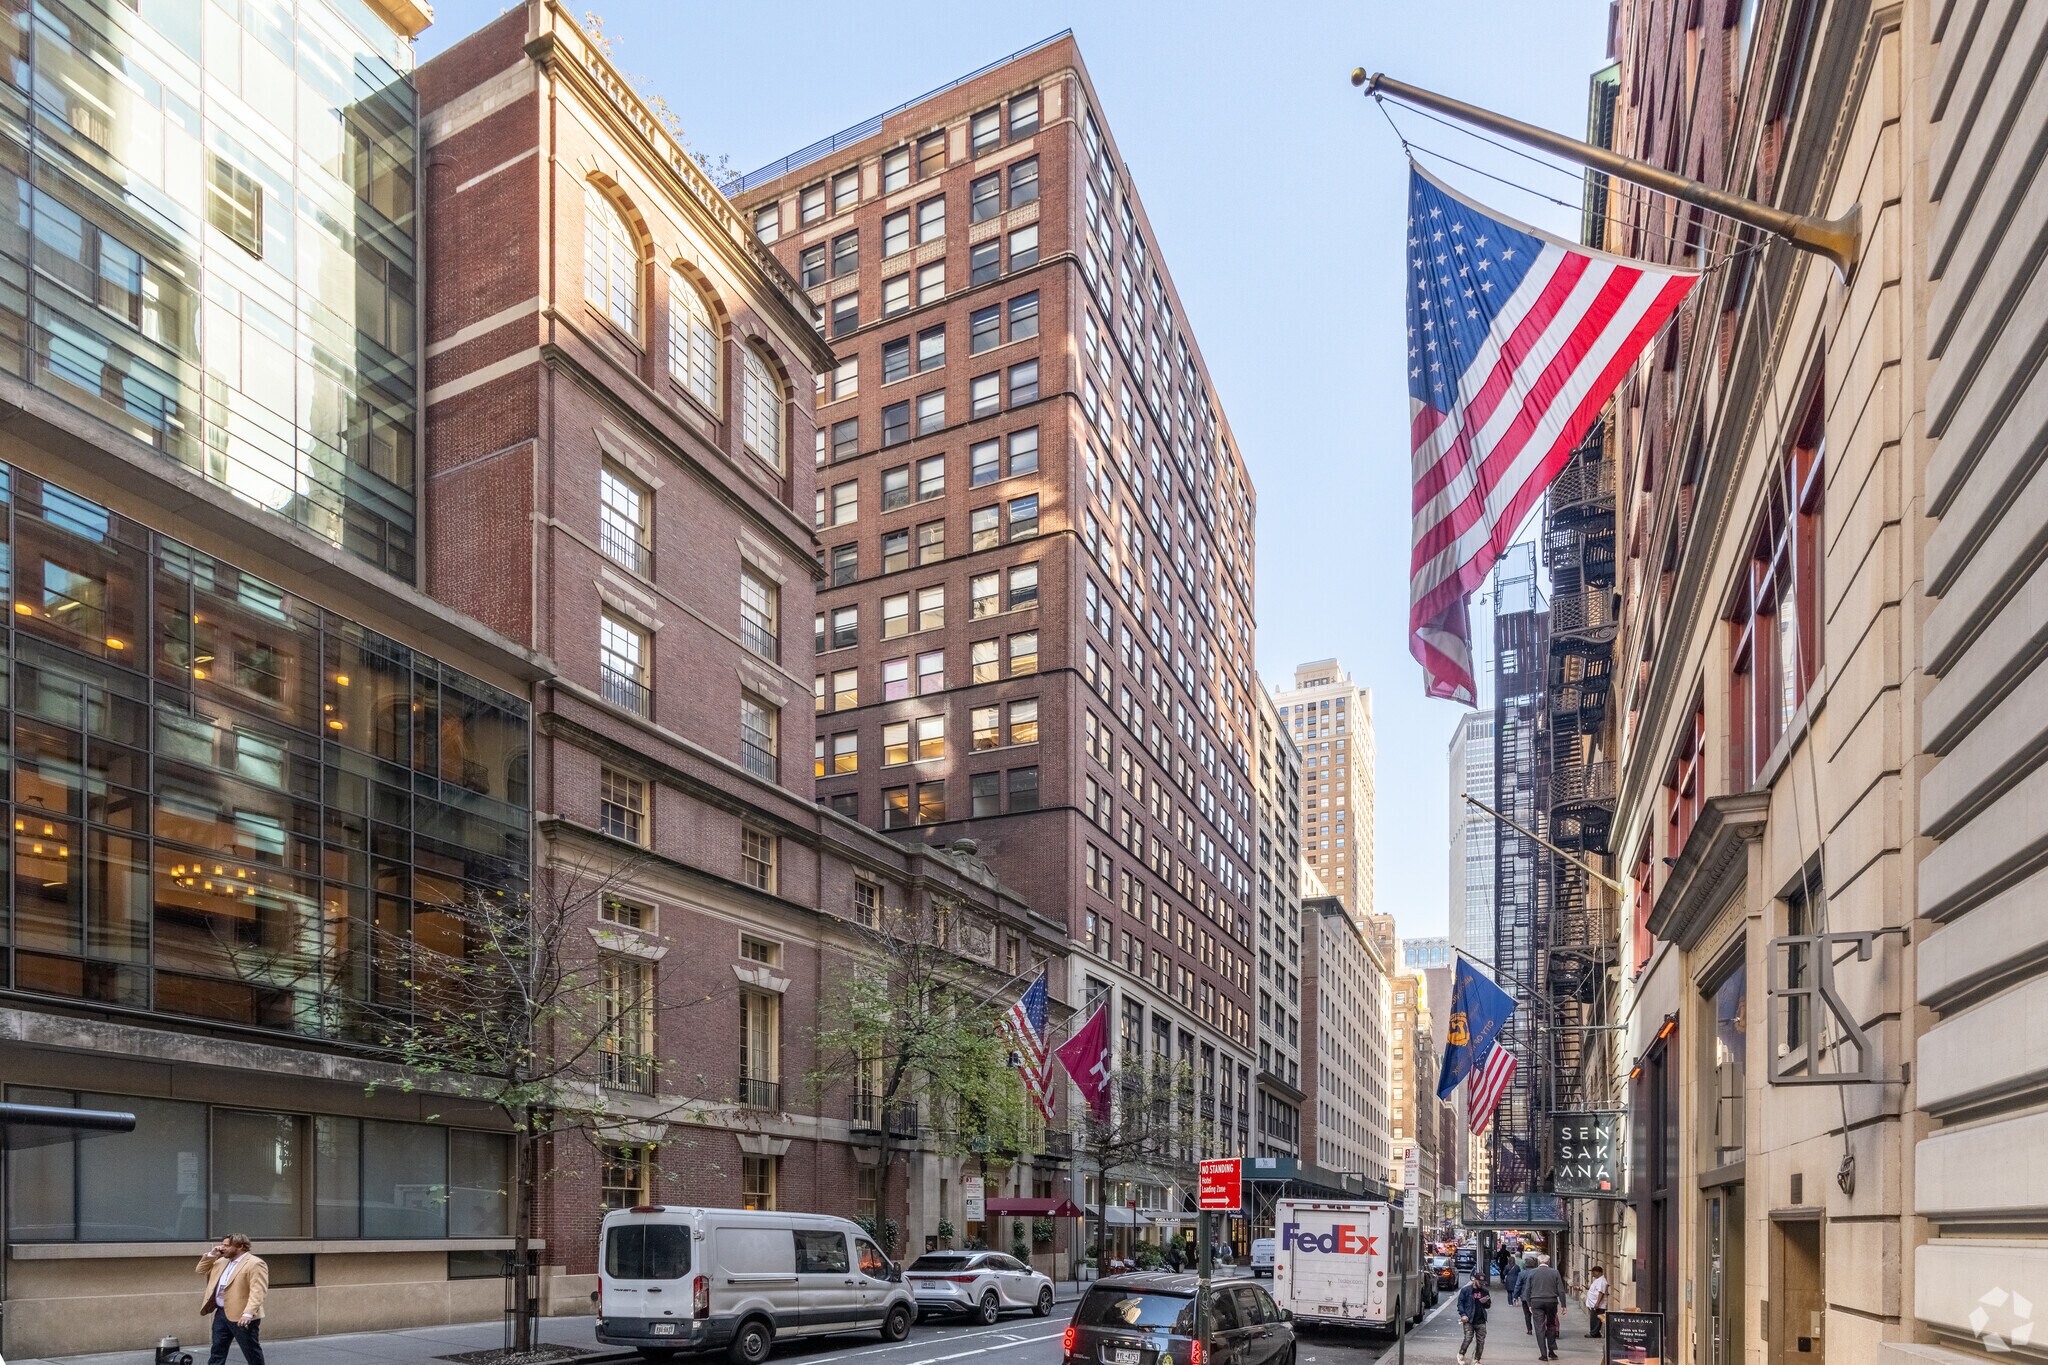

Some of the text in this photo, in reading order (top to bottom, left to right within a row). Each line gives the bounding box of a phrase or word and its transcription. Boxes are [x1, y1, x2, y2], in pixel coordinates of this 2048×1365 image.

[1561, 1126, 1609, 1140] SEN
[1561, 1145, 1609, 1159] SAK
[1201, 1163, 1234, 1174] NO STANDING
[1560, 1164, 1610, 1178] ANA
[1201, 1176, 1212, 1184] Hotel
[1201, 1184, 1226, 1194] Loading Zone
[1282, 1222, 1380, 1256] FedEx
